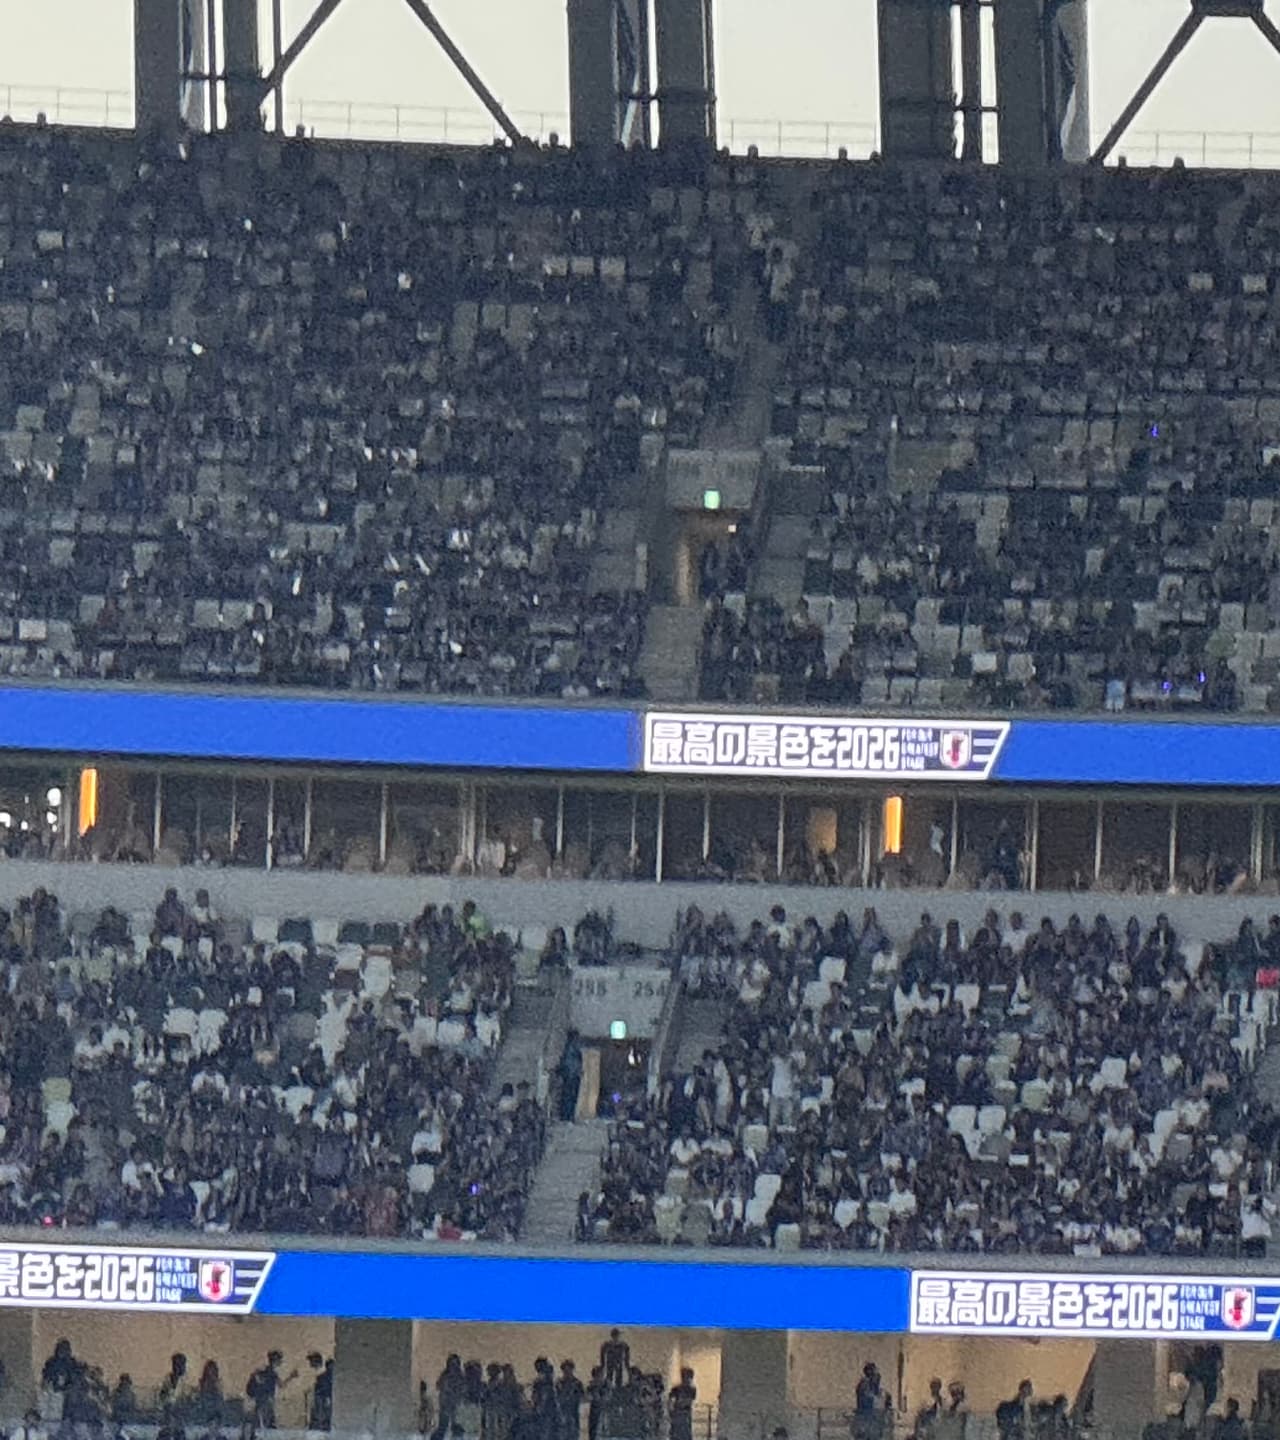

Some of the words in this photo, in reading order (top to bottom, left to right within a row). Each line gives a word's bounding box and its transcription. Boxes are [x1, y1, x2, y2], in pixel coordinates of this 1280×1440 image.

[652, 721, 898, 770] 最高の景色を2026
[918, 1279, 1178, 1328] 最高の景色を2026
